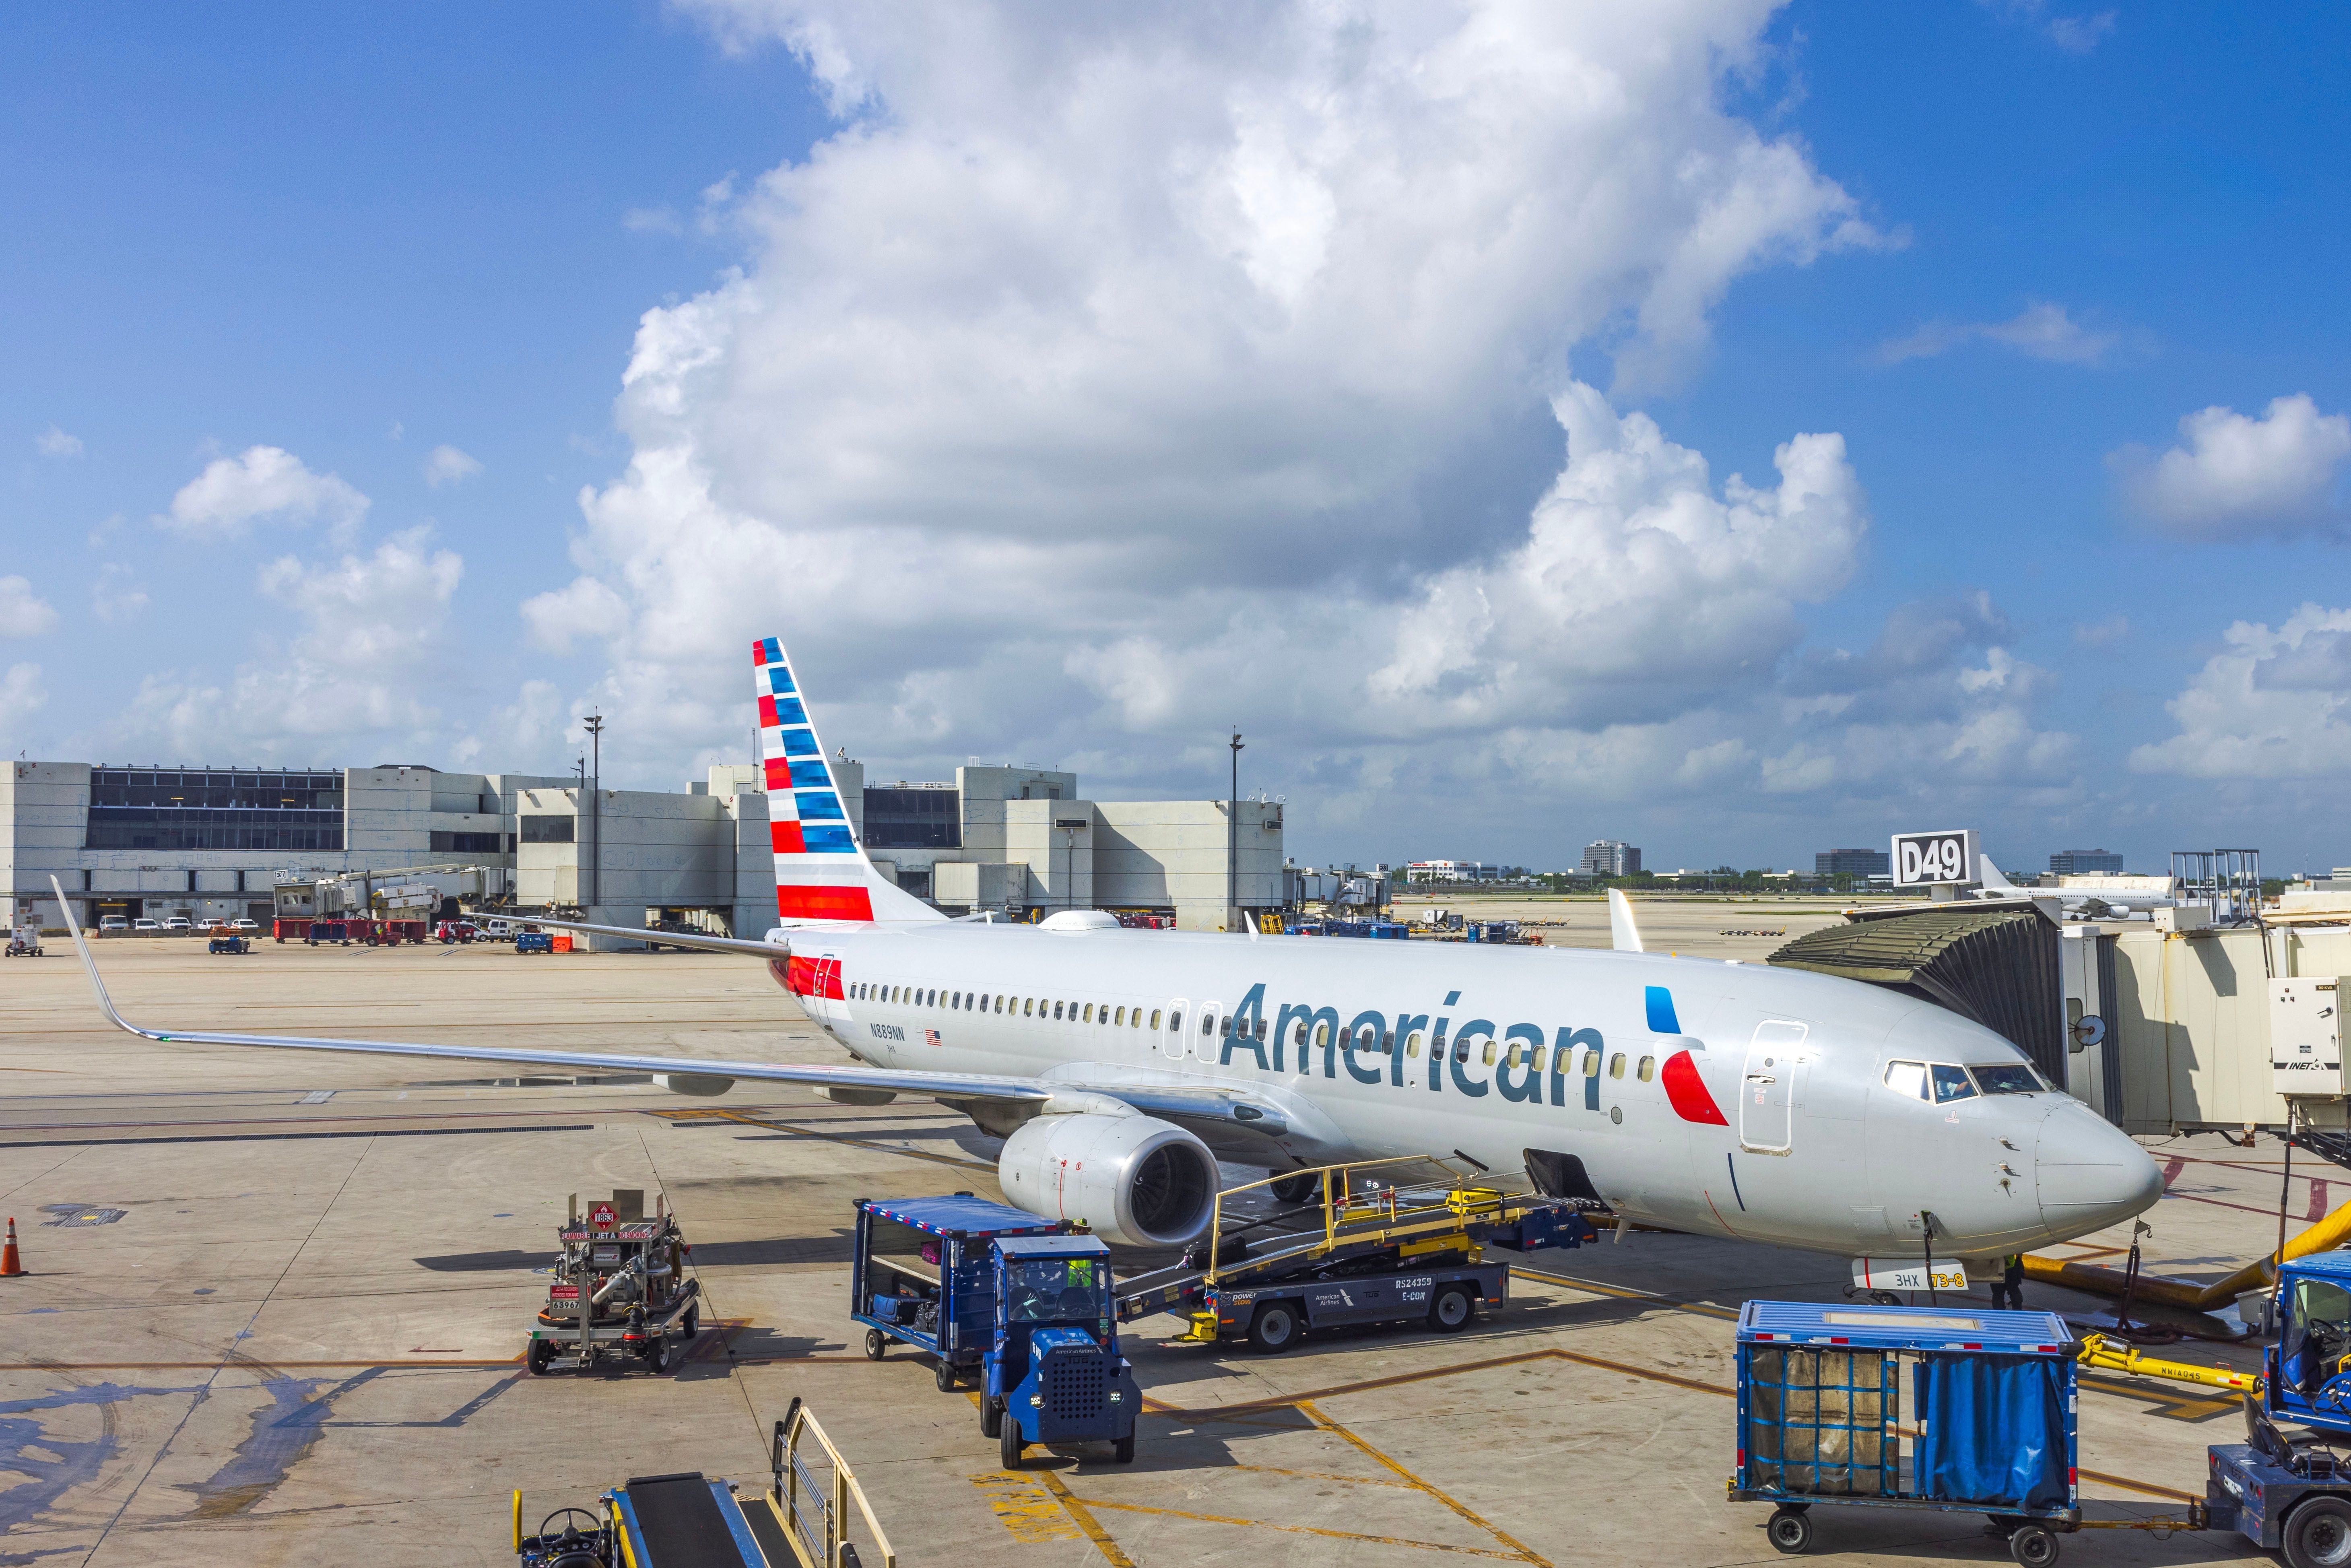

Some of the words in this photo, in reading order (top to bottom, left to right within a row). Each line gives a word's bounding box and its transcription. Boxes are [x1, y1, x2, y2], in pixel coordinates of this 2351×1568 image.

[1901, 839, 1961, 882] D49
[870, 1023, 905, 1041] N889NN
[887, 1045, 896, 1053] 3HX
[1220, 983, 1604, 1111] American
[1396, 1277, 1431, 1288] RS24359
[1895, 1274, 1920, 1287] 3HX
[1931, 1273, 1965, 1287] 73-8
[1232, 1293, 1257, 1301] power
[1402, 1292, 1425, 1301] E-CON
[1064, 1355, 1089, 1364] TUG
